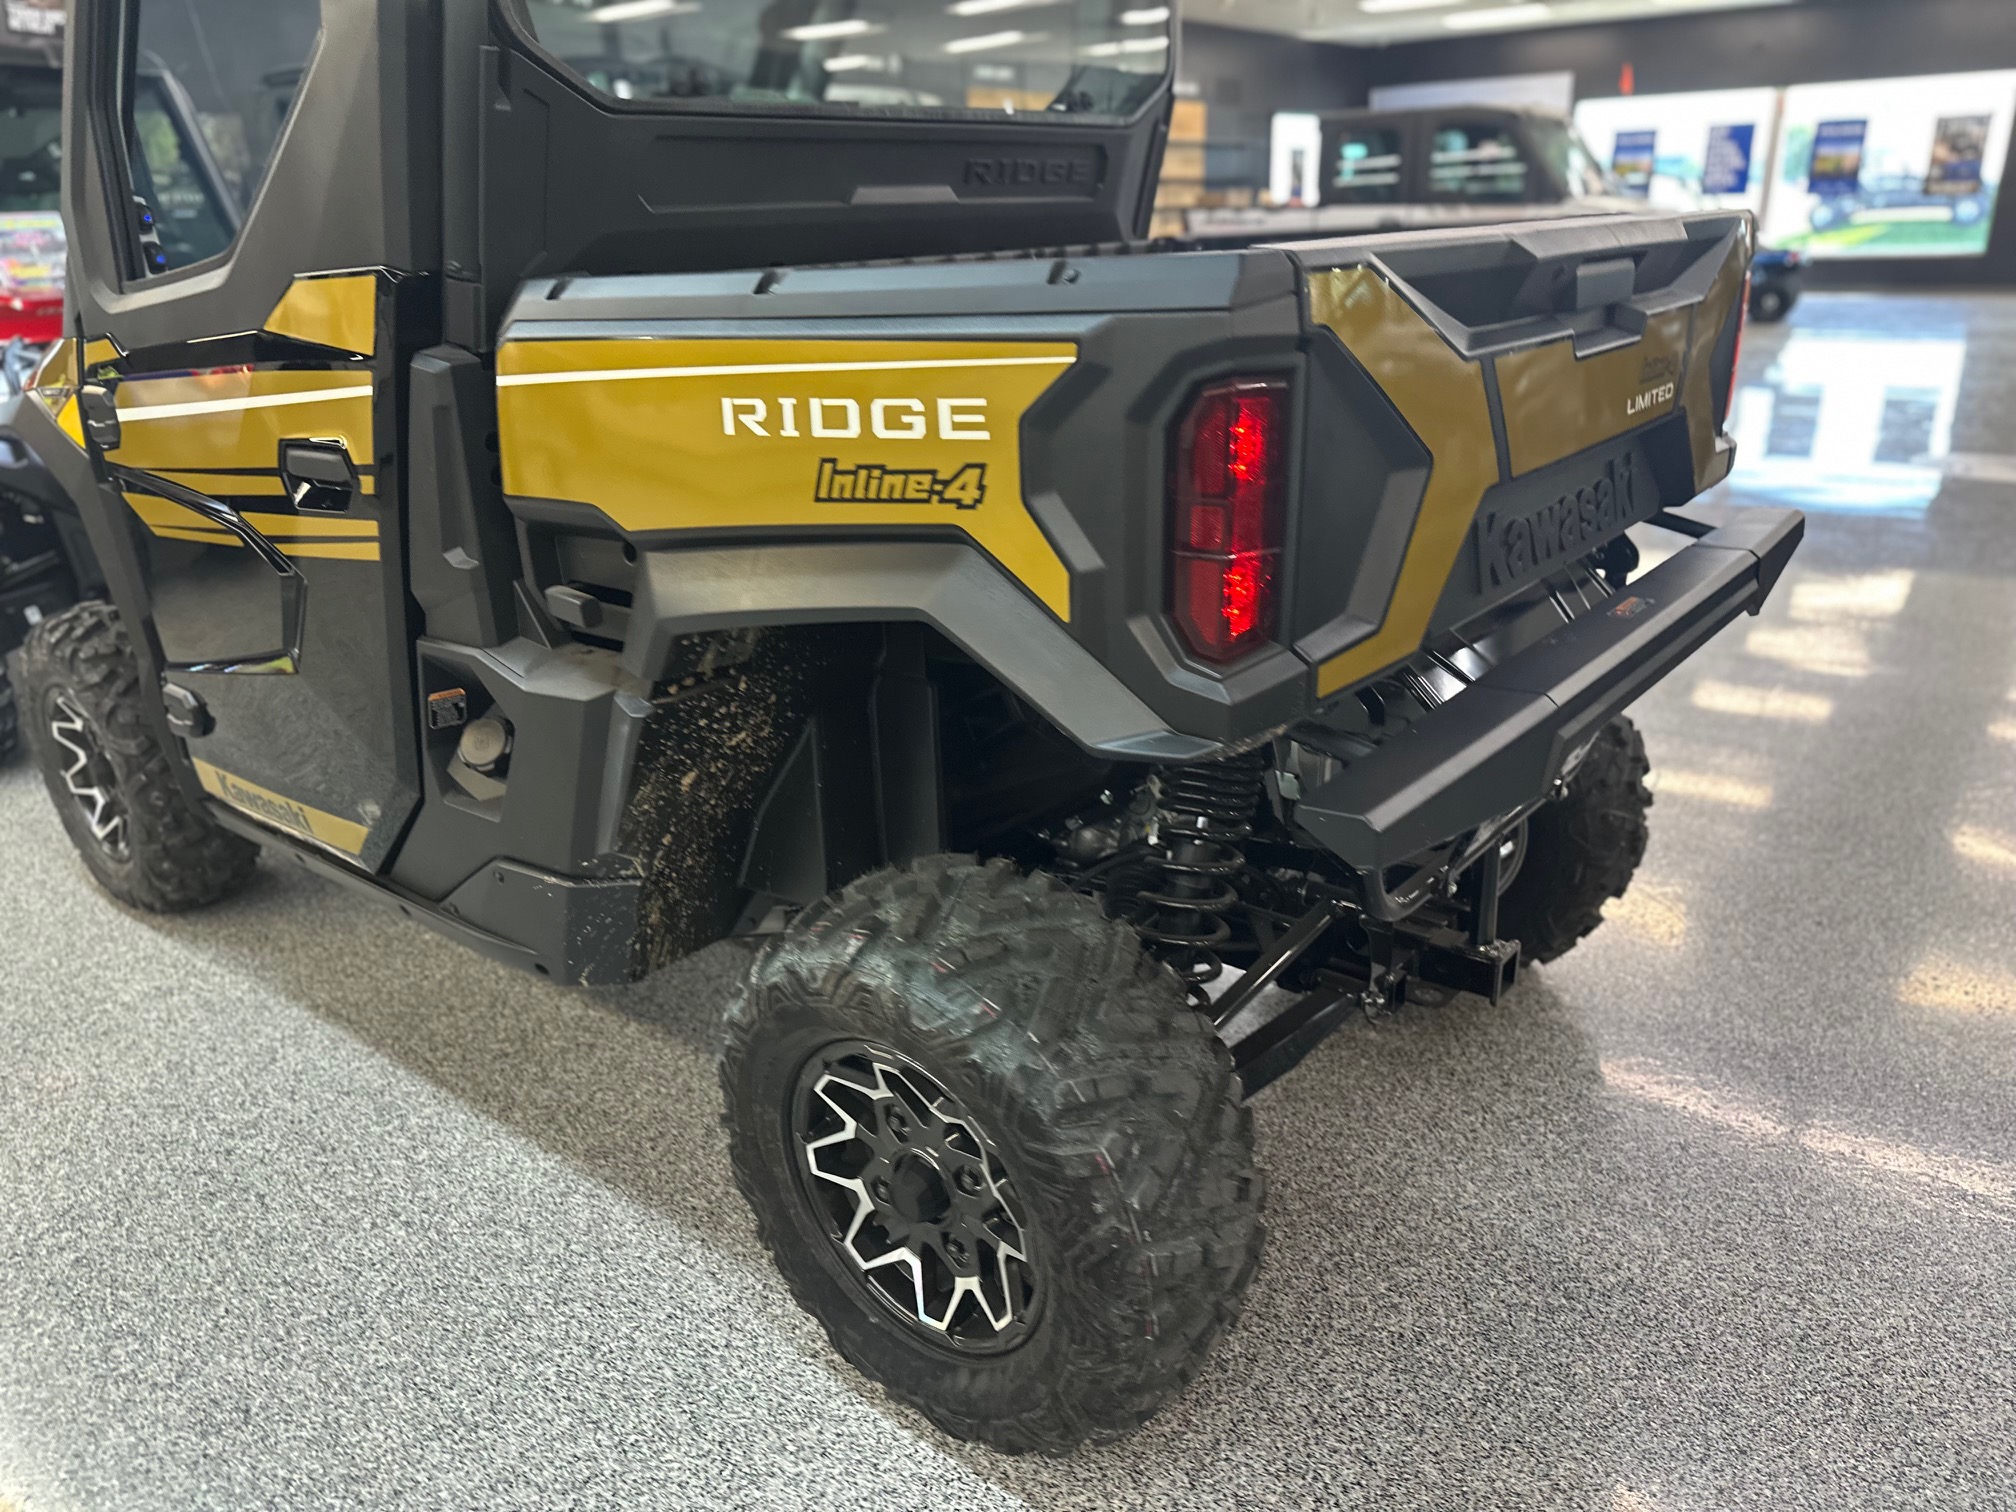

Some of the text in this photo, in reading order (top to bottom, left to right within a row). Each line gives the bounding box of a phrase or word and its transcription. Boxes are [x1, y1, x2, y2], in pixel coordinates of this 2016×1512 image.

[963, 158, 1091, 184] RIDGE
[721, 397, 991, 440] RIDGE
[1627, 382, 1674, 416] LIMITED
[813, 457, 987, 510] Inline-4
[1472, 452, 1634, 594] Kawasaki
[215, 769, 314, 835] Kawasaki
